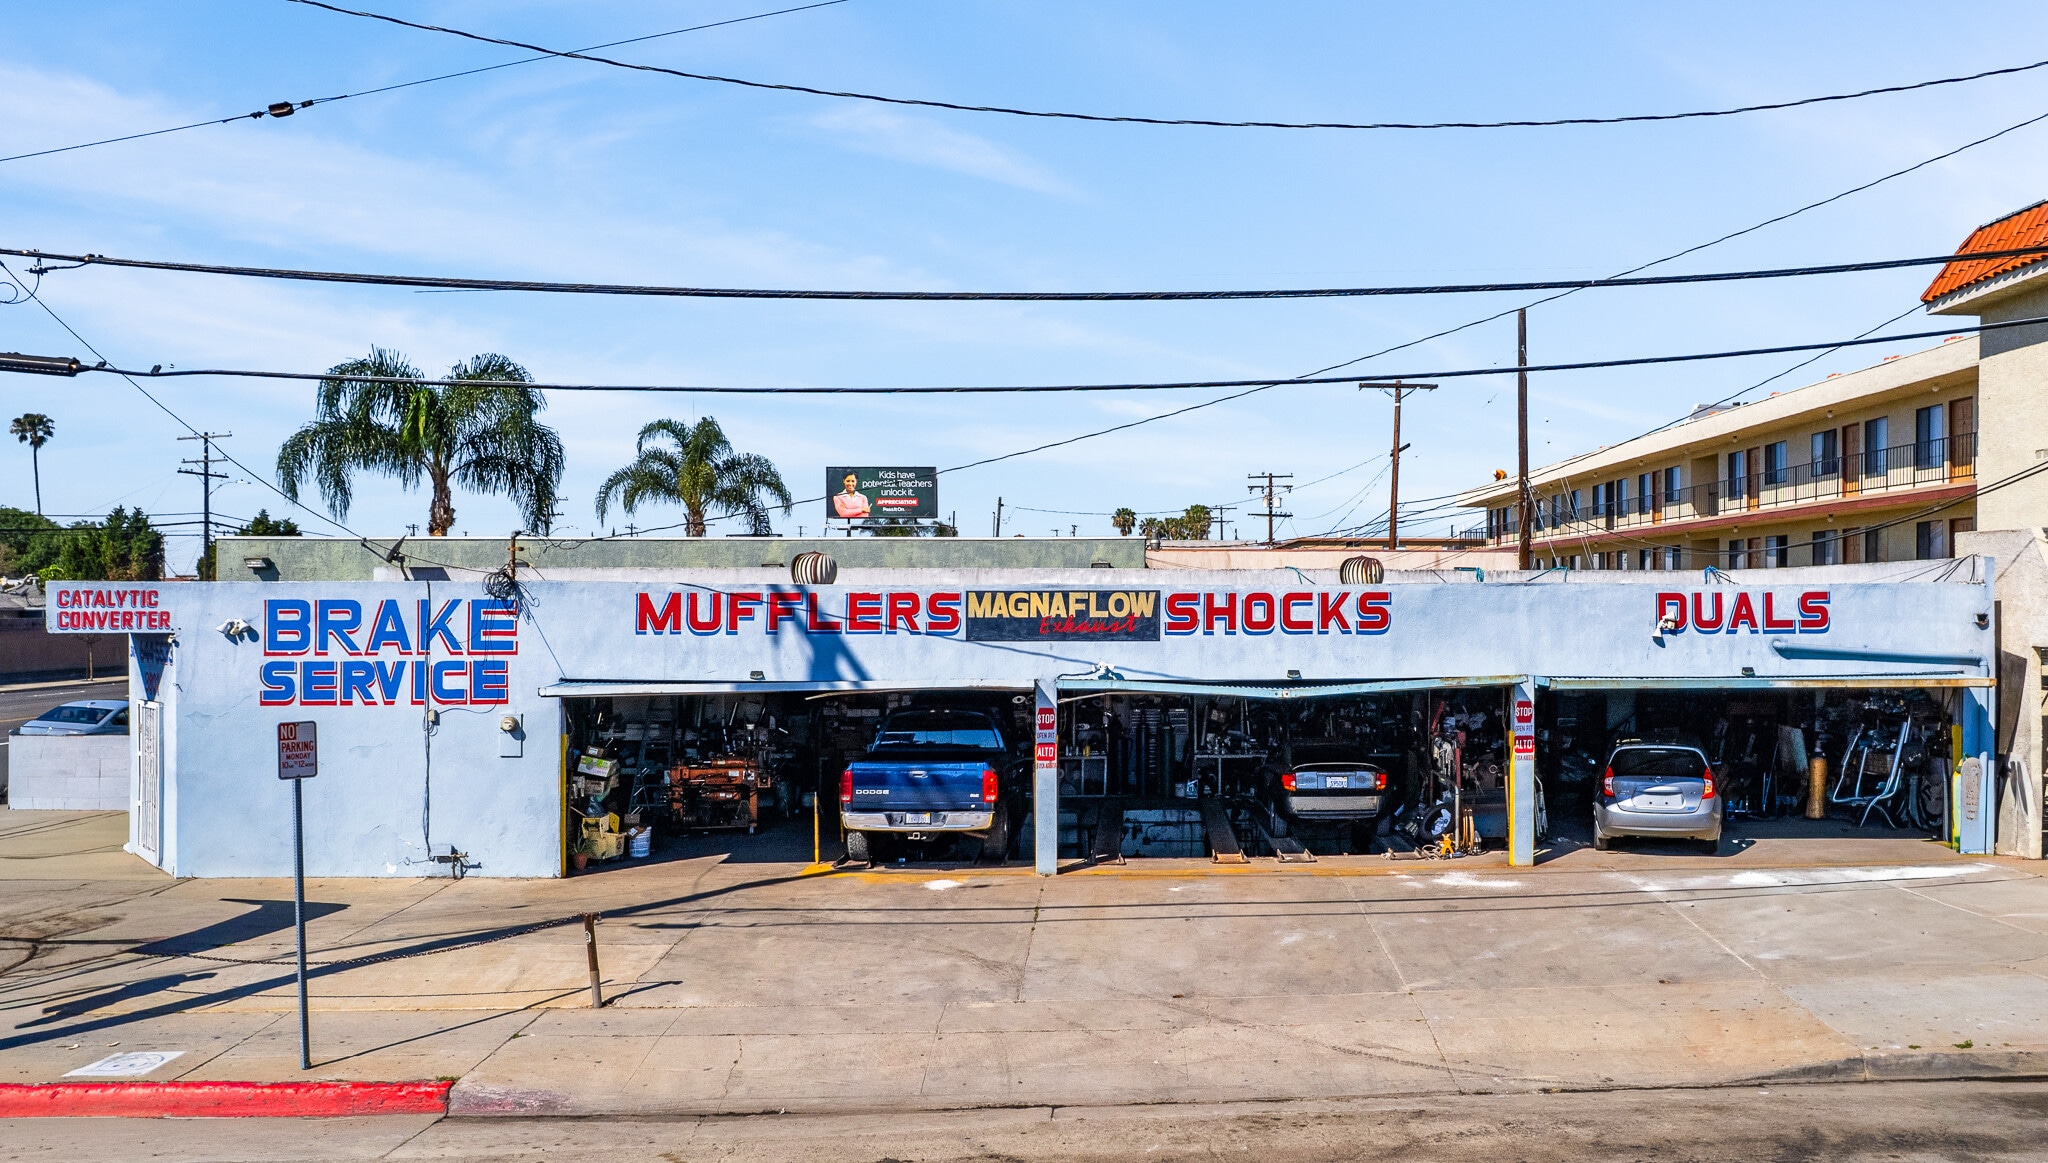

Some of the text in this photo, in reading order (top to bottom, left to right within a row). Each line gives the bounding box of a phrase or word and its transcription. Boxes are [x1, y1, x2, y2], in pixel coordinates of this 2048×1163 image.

[881, 488, 906, 496] unlock
[57, 590, 159, 608] CATALYTIC
[967, 591, 1156, 618] MAGNAFLOW
[57, 611, 171, 630] CONVERTER
[635, 592, 961, 636] MUFFLERS
[1164, 591, 1392, 636] SHOCKS
[1656, 591, 1831, 634] DUALS
[263, 599, 518, 656] BRAKE
[1039, 612, 1141, 634] Exhaust
[260, 660, 508, 706] SERVICE
[1038, 714, 1054, 724] STOP
[1516, 707, 1532, 716] STOP
[280, 725, 294, 739] NO
[281, 741, 314, 753] PARKING
[1038, 747, 1054, 757] ALTO
[1516, 739, 1532, 749] ALTO
